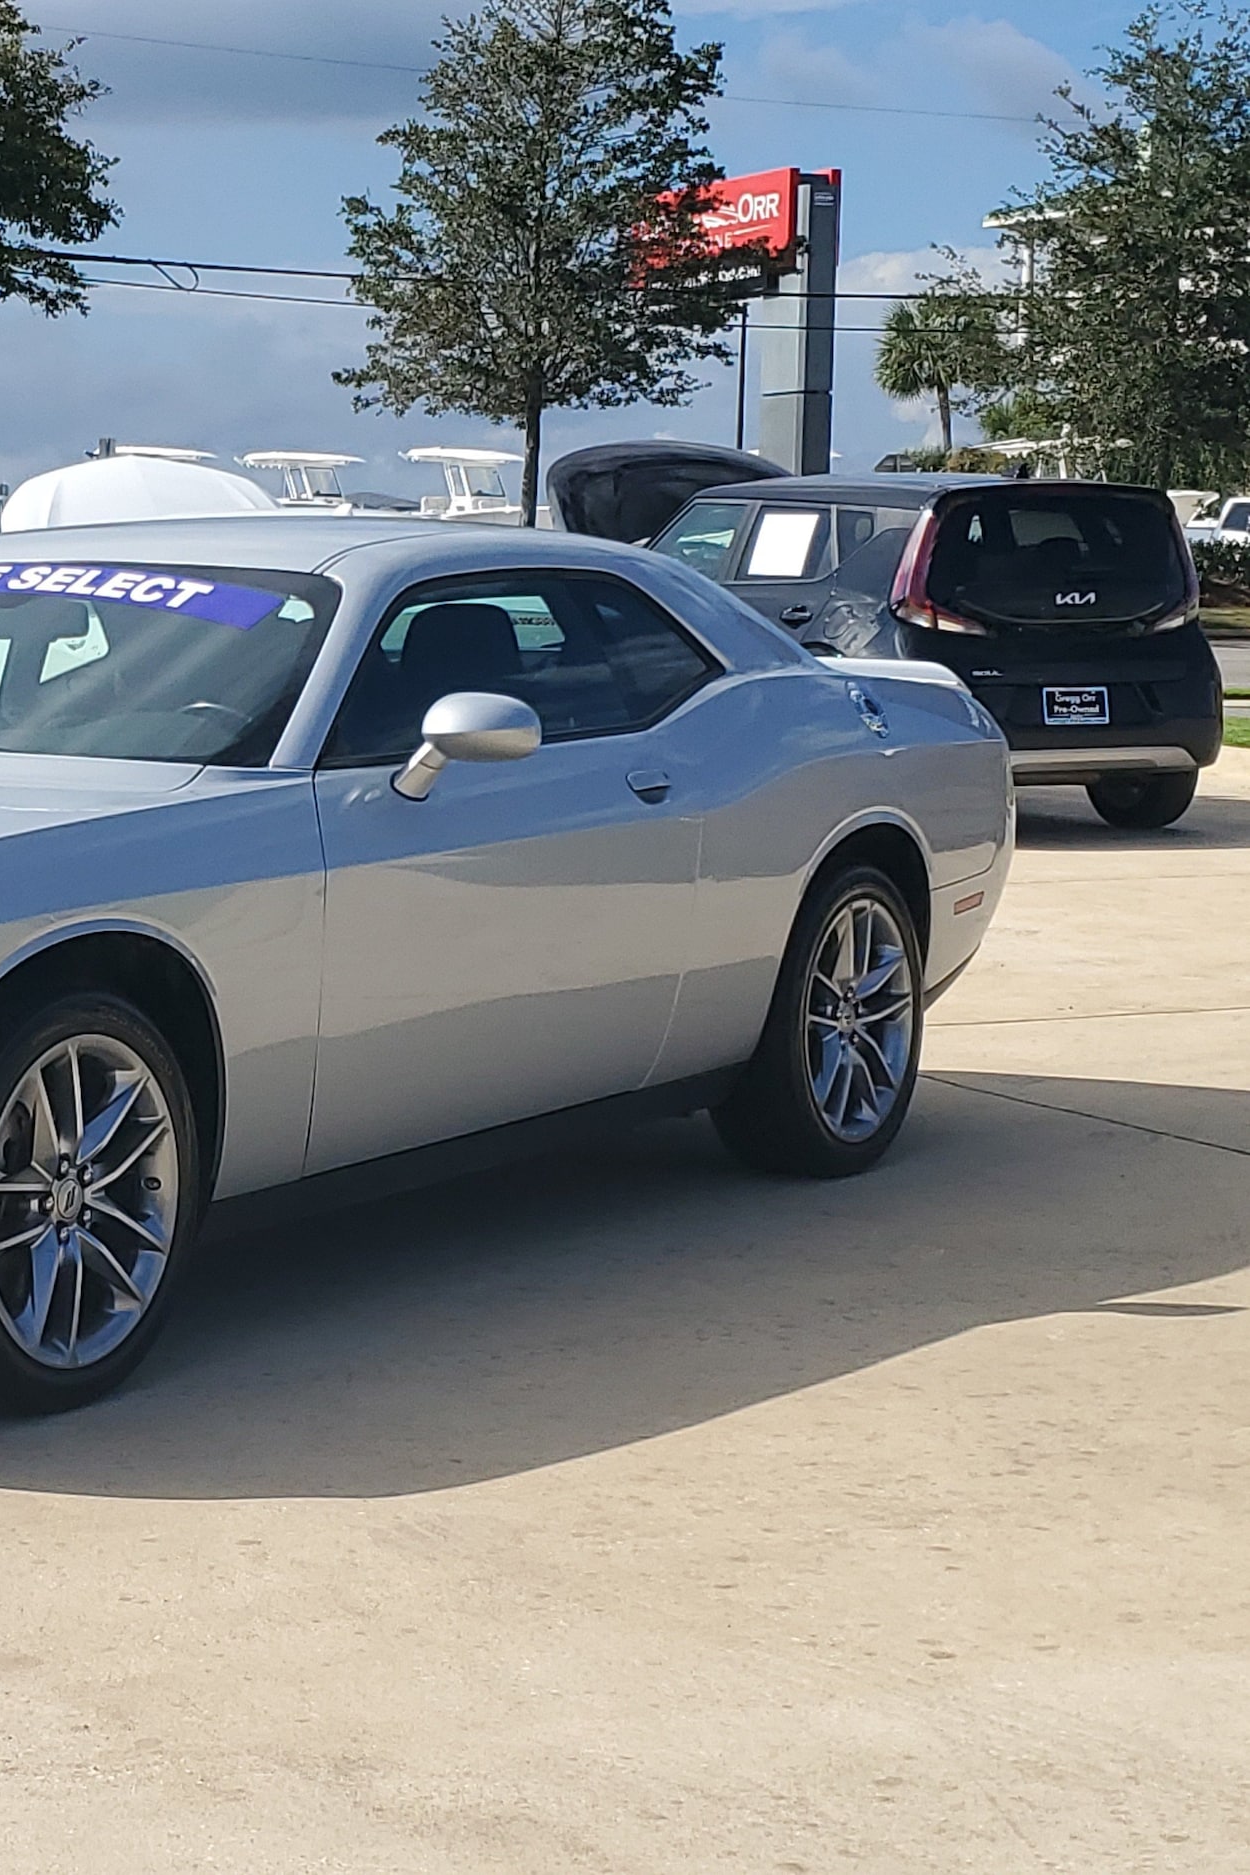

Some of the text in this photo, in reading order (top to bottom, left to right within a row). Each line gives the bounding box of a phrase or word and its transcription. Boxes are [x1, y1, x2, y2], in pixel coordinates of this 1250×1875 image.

[8, 566, 214, 608] SELECT
[1055, 592, 1096, 605] KIA
[1081, 693, 1096, 702] Orr
